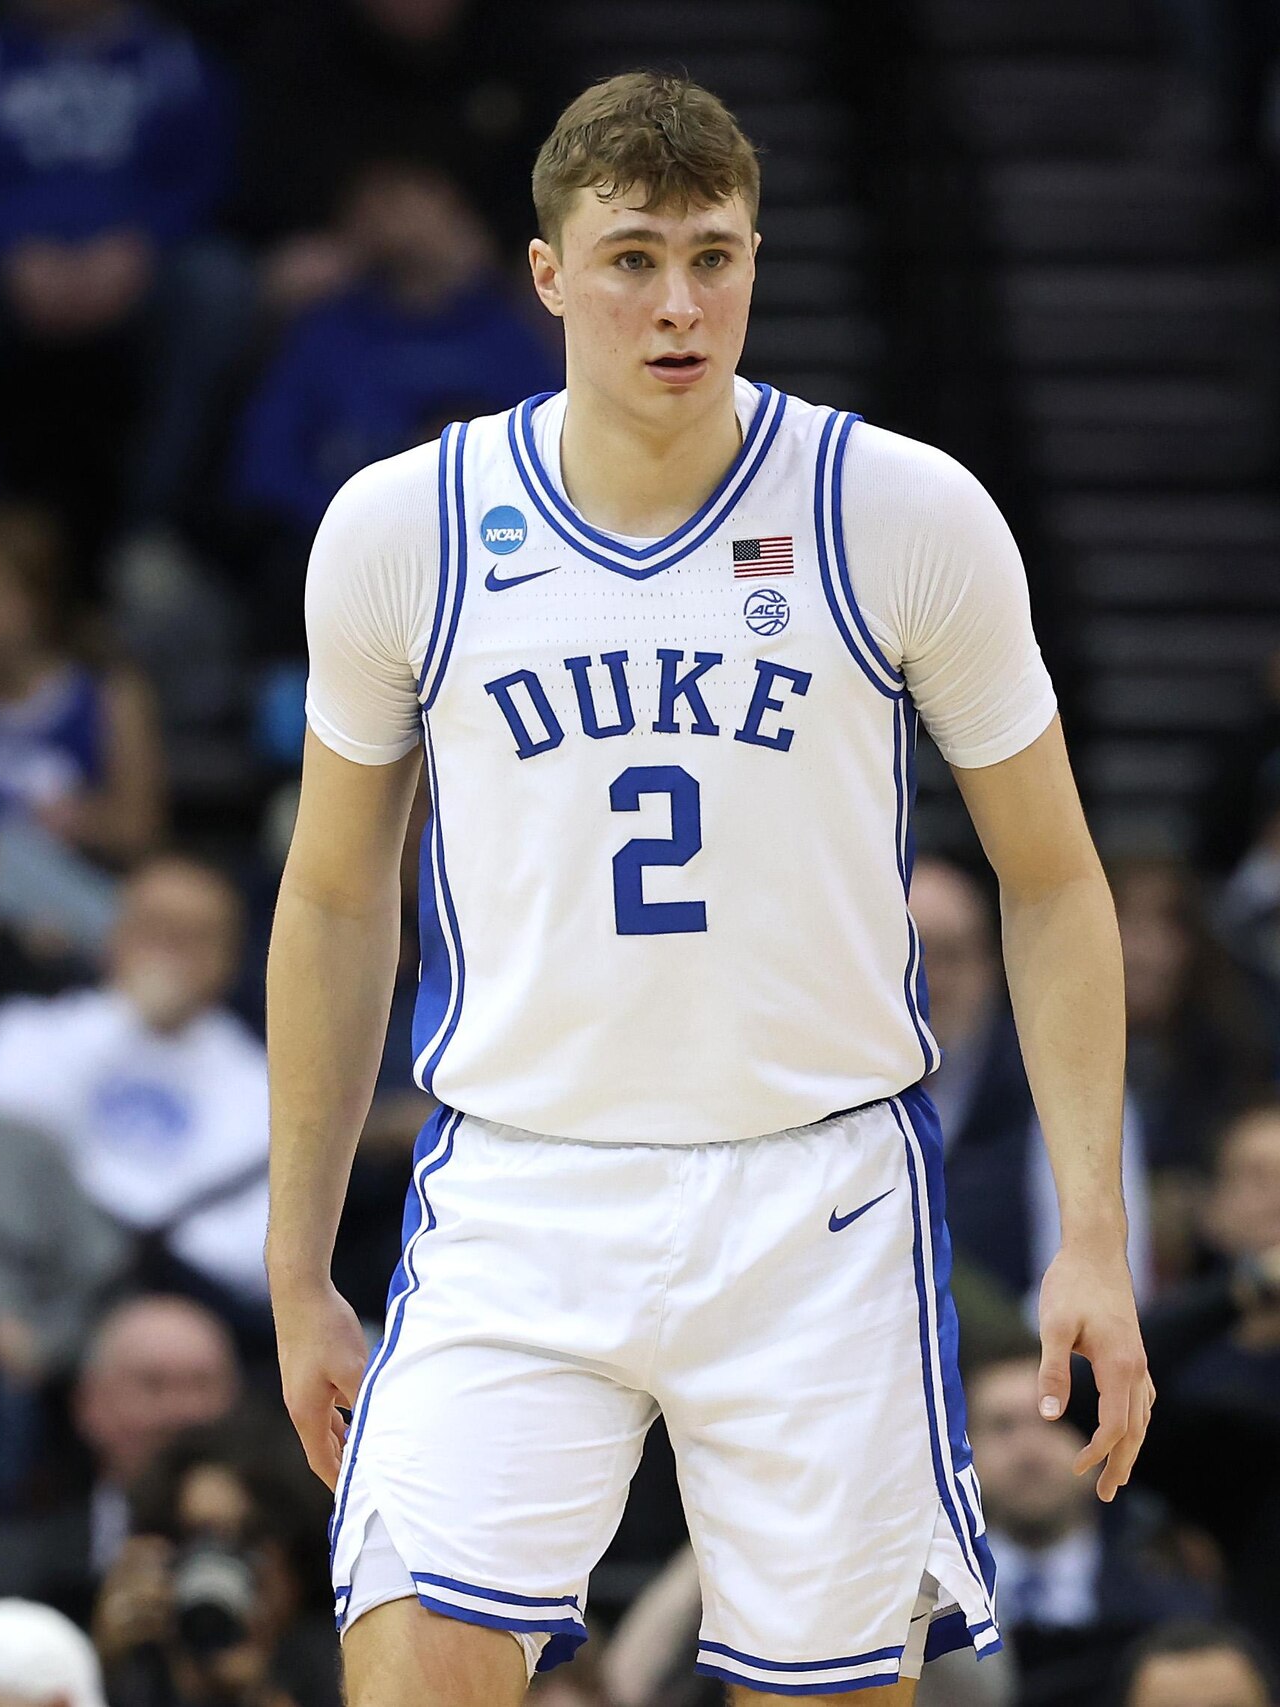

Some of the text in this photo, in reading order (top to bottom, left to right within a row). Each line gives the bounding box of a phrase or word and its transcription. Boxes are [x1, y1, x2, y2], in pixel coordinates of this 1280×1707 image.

[485, 528, 524, 542] NCAA
[750, 604, 787, 616] ACC
[483, 648, 812, 760] DUKE
[609, 765, 708, 935] 2
